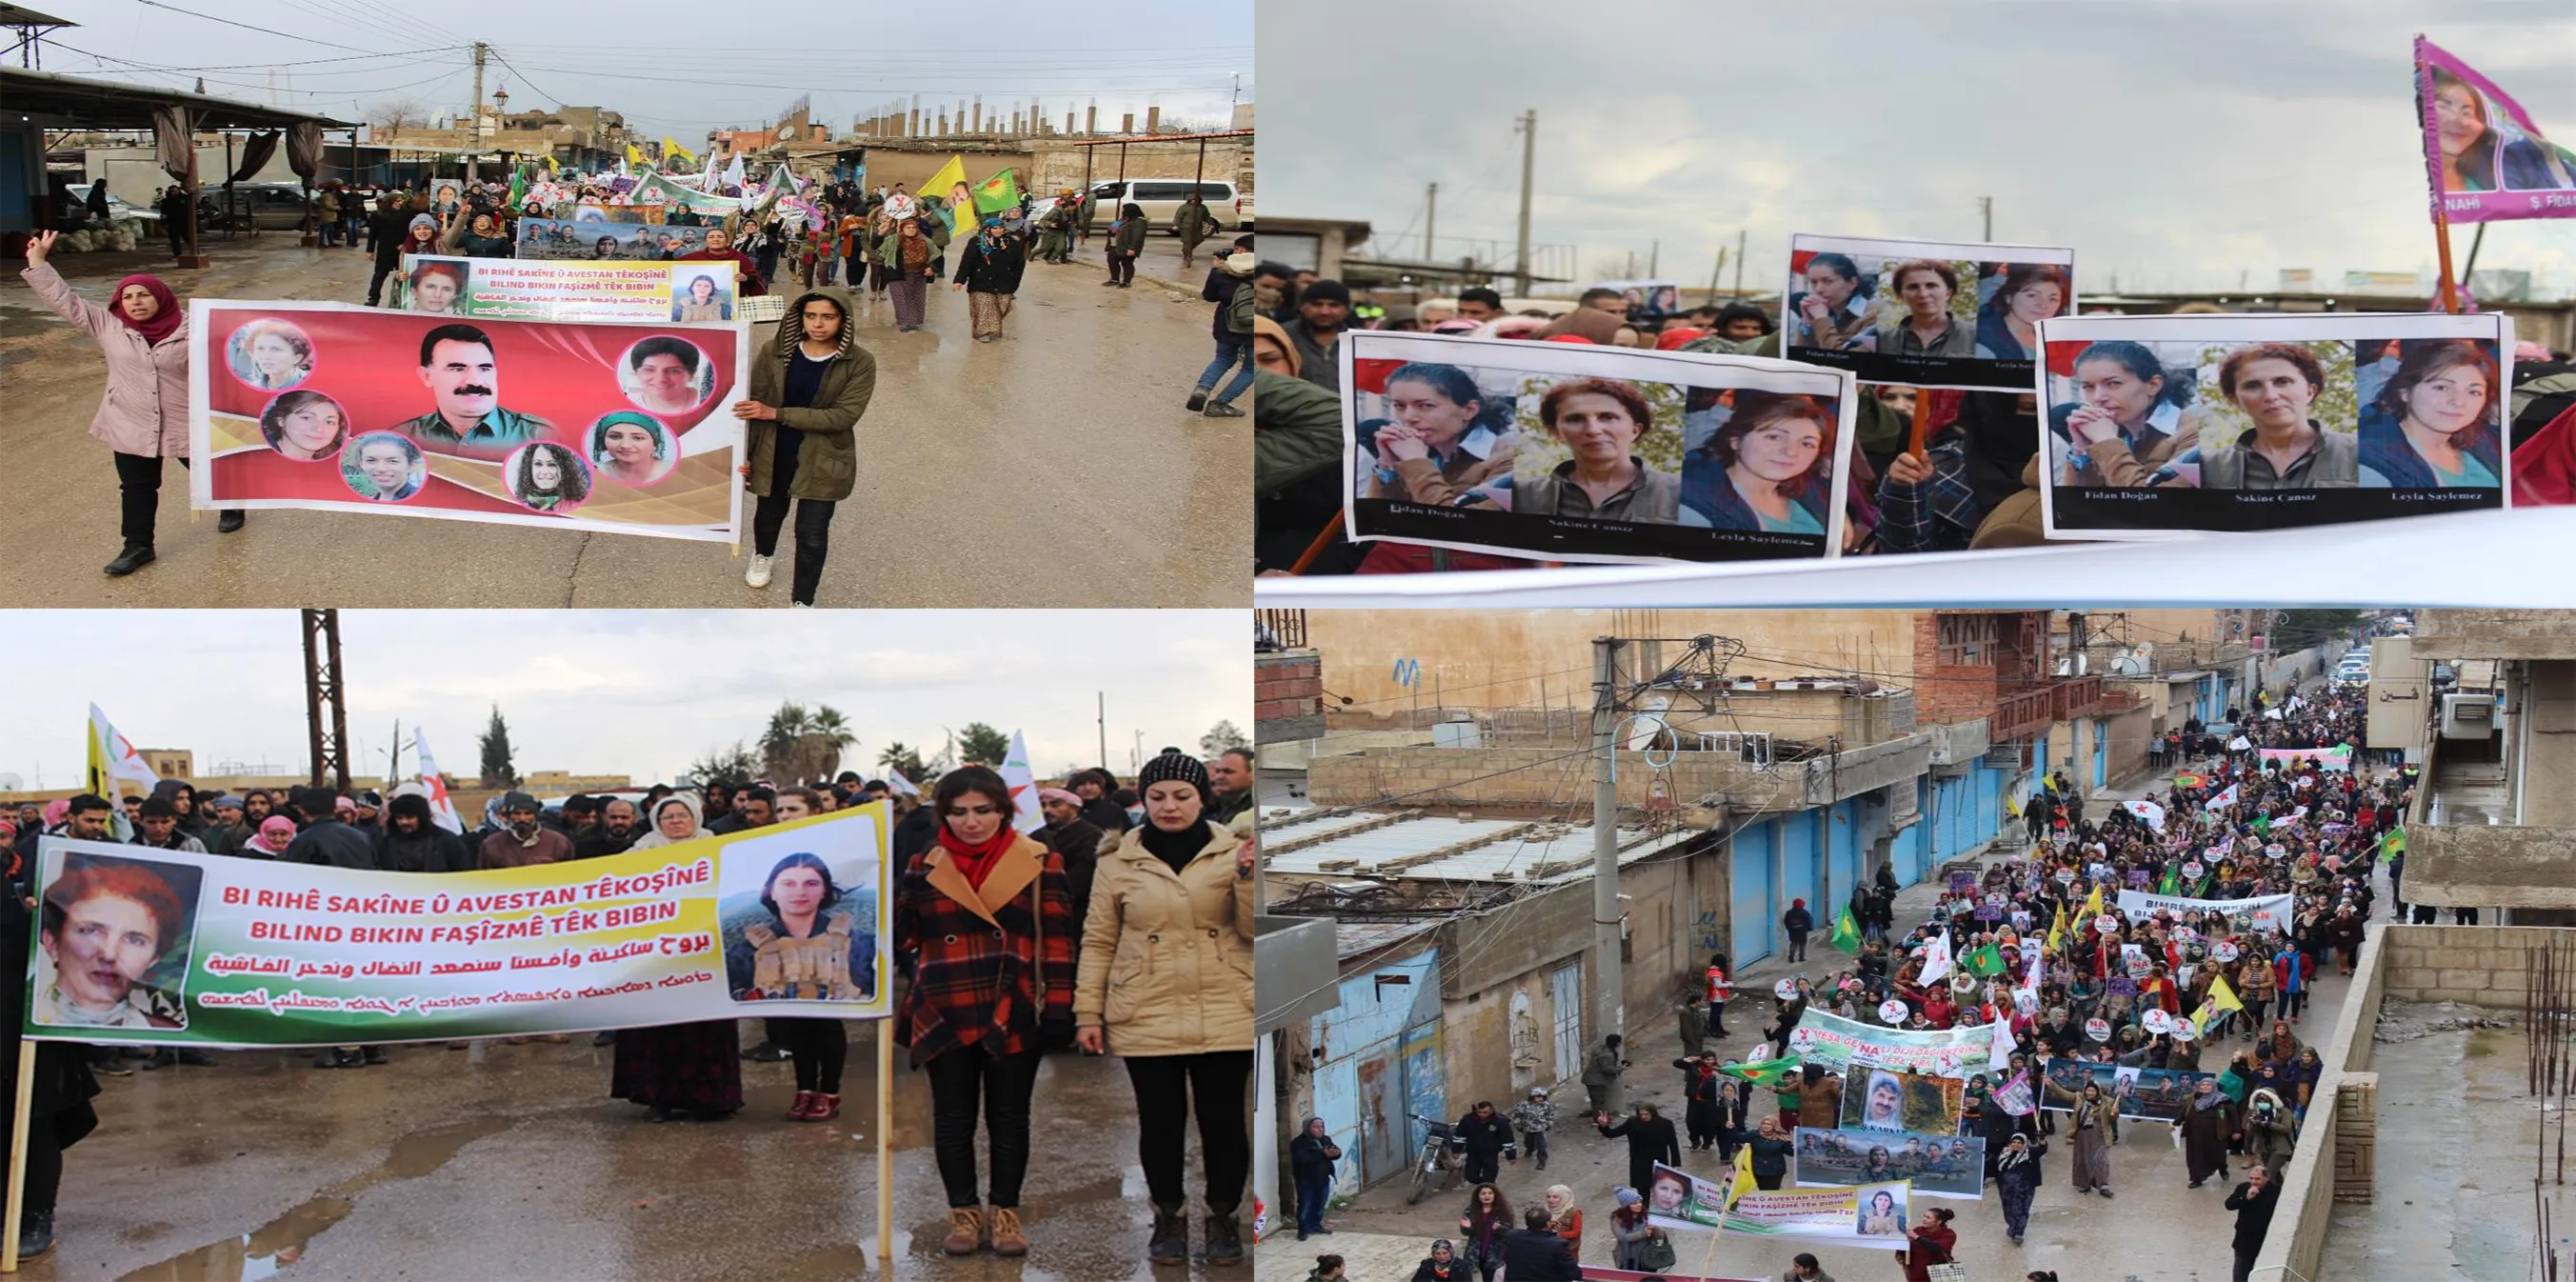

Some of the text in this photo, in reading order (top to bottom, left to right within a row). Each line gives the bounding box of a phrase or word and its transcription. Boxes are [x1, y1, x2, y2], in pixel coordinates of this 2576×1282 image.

[490, 268, 515, 276] RIHÊ
[517, 269, 555, 277] SAKÎNE
[615, 270, 667, 279] TÊKOŞÎNÊ
[558, 281, 601, 290] FAŞÎZMÊ
[2391, 492, 2424, 502] Leyla
[223, 860, 709, 914] BI RIHÊ SAKÎNE Û AVESTAN TÊKOŞÎNÊ
[250, 901, 676, 946] BILIND BIKIN FAŞÎZMÊ TÊK BIBIN
[588, 940, 654, 964] ساكينة
[660, 934, 710, 955] بروح
[208, 954, 290, 974] الفاشية
[295, 962, 354, 979] وندحر
[361, 960, 423, 976] النضال
[1860, 1044, 1880, 1055] NA
